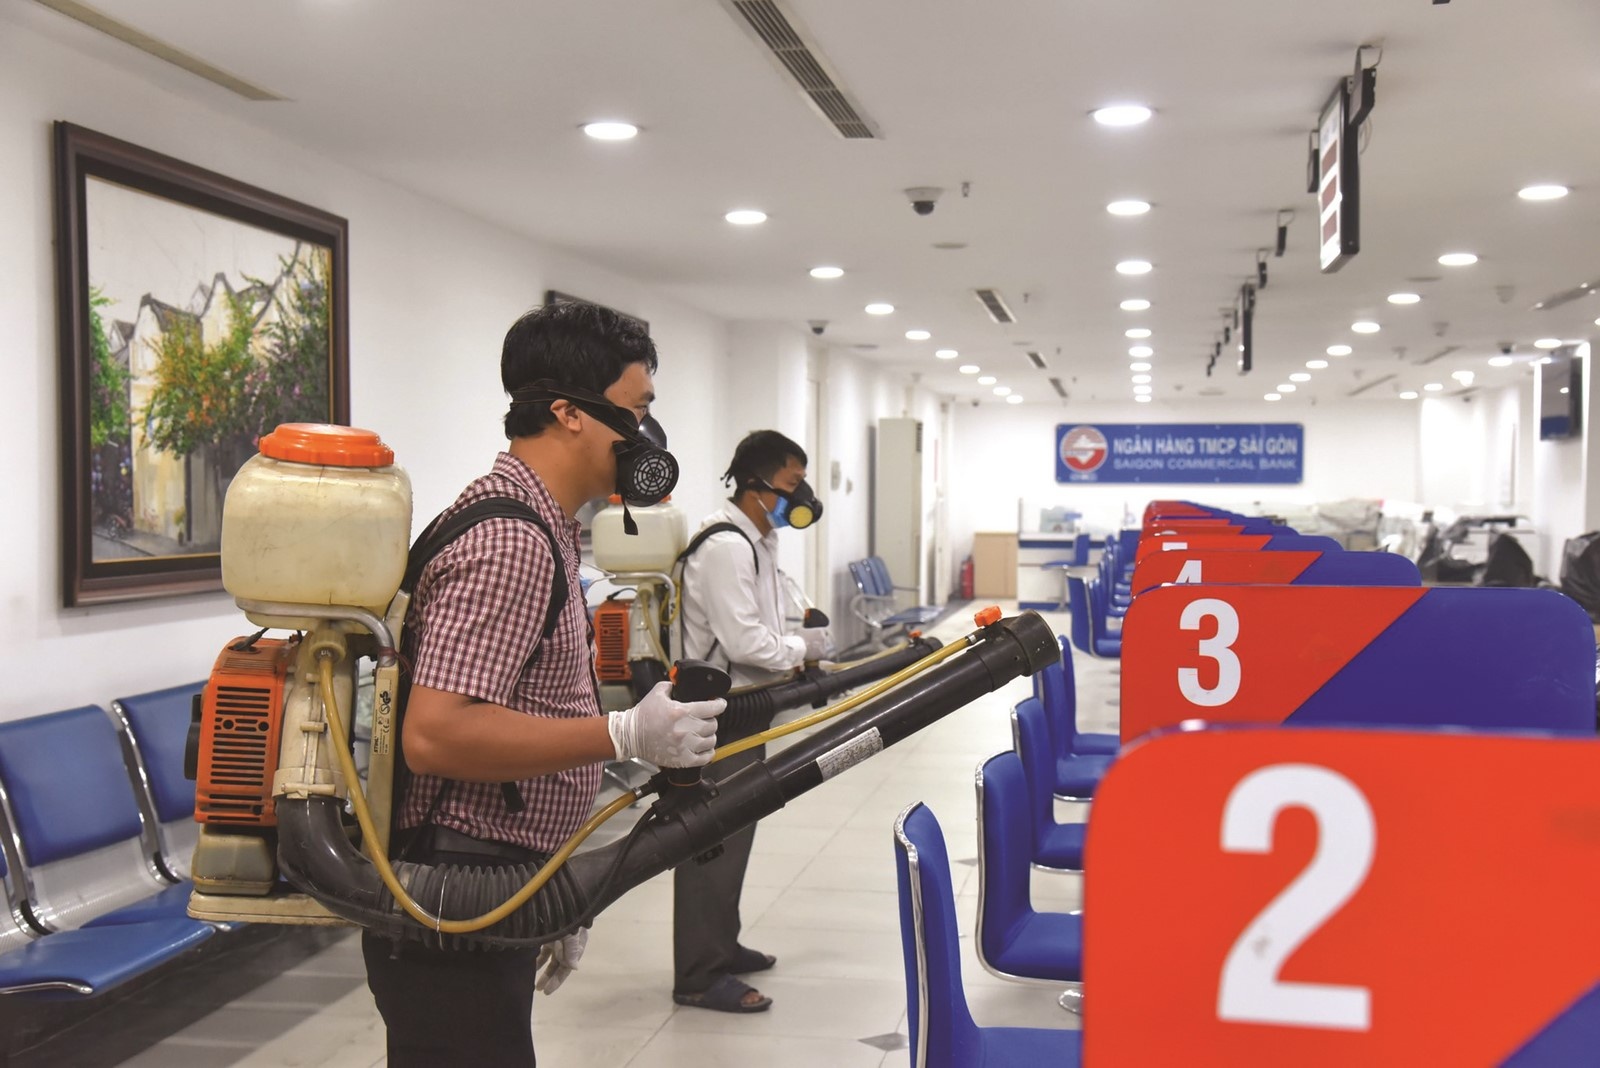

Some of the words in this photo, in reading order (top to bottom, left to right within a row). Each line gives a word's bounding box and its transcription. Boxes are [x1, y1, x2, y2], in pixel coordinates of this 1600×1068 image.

[1113, 434, 1152, 455] NGÂN
[1155, 434, 1195, 455] HÀNG
[1198, 437, 1237, 455] TMCP
[1239, 433, 1264, 455] SÀI
[1265, 433, 1298, 455] GÒN
[1113, 458, 1164, 470] SAIGON
[1167, 458, 1254, 470] COMMERCIAL
[1259, 458, 1296, 470] BANK
[1178, 598, 1241, 706] 3
[1218, 763, 1376, 1030] 2
